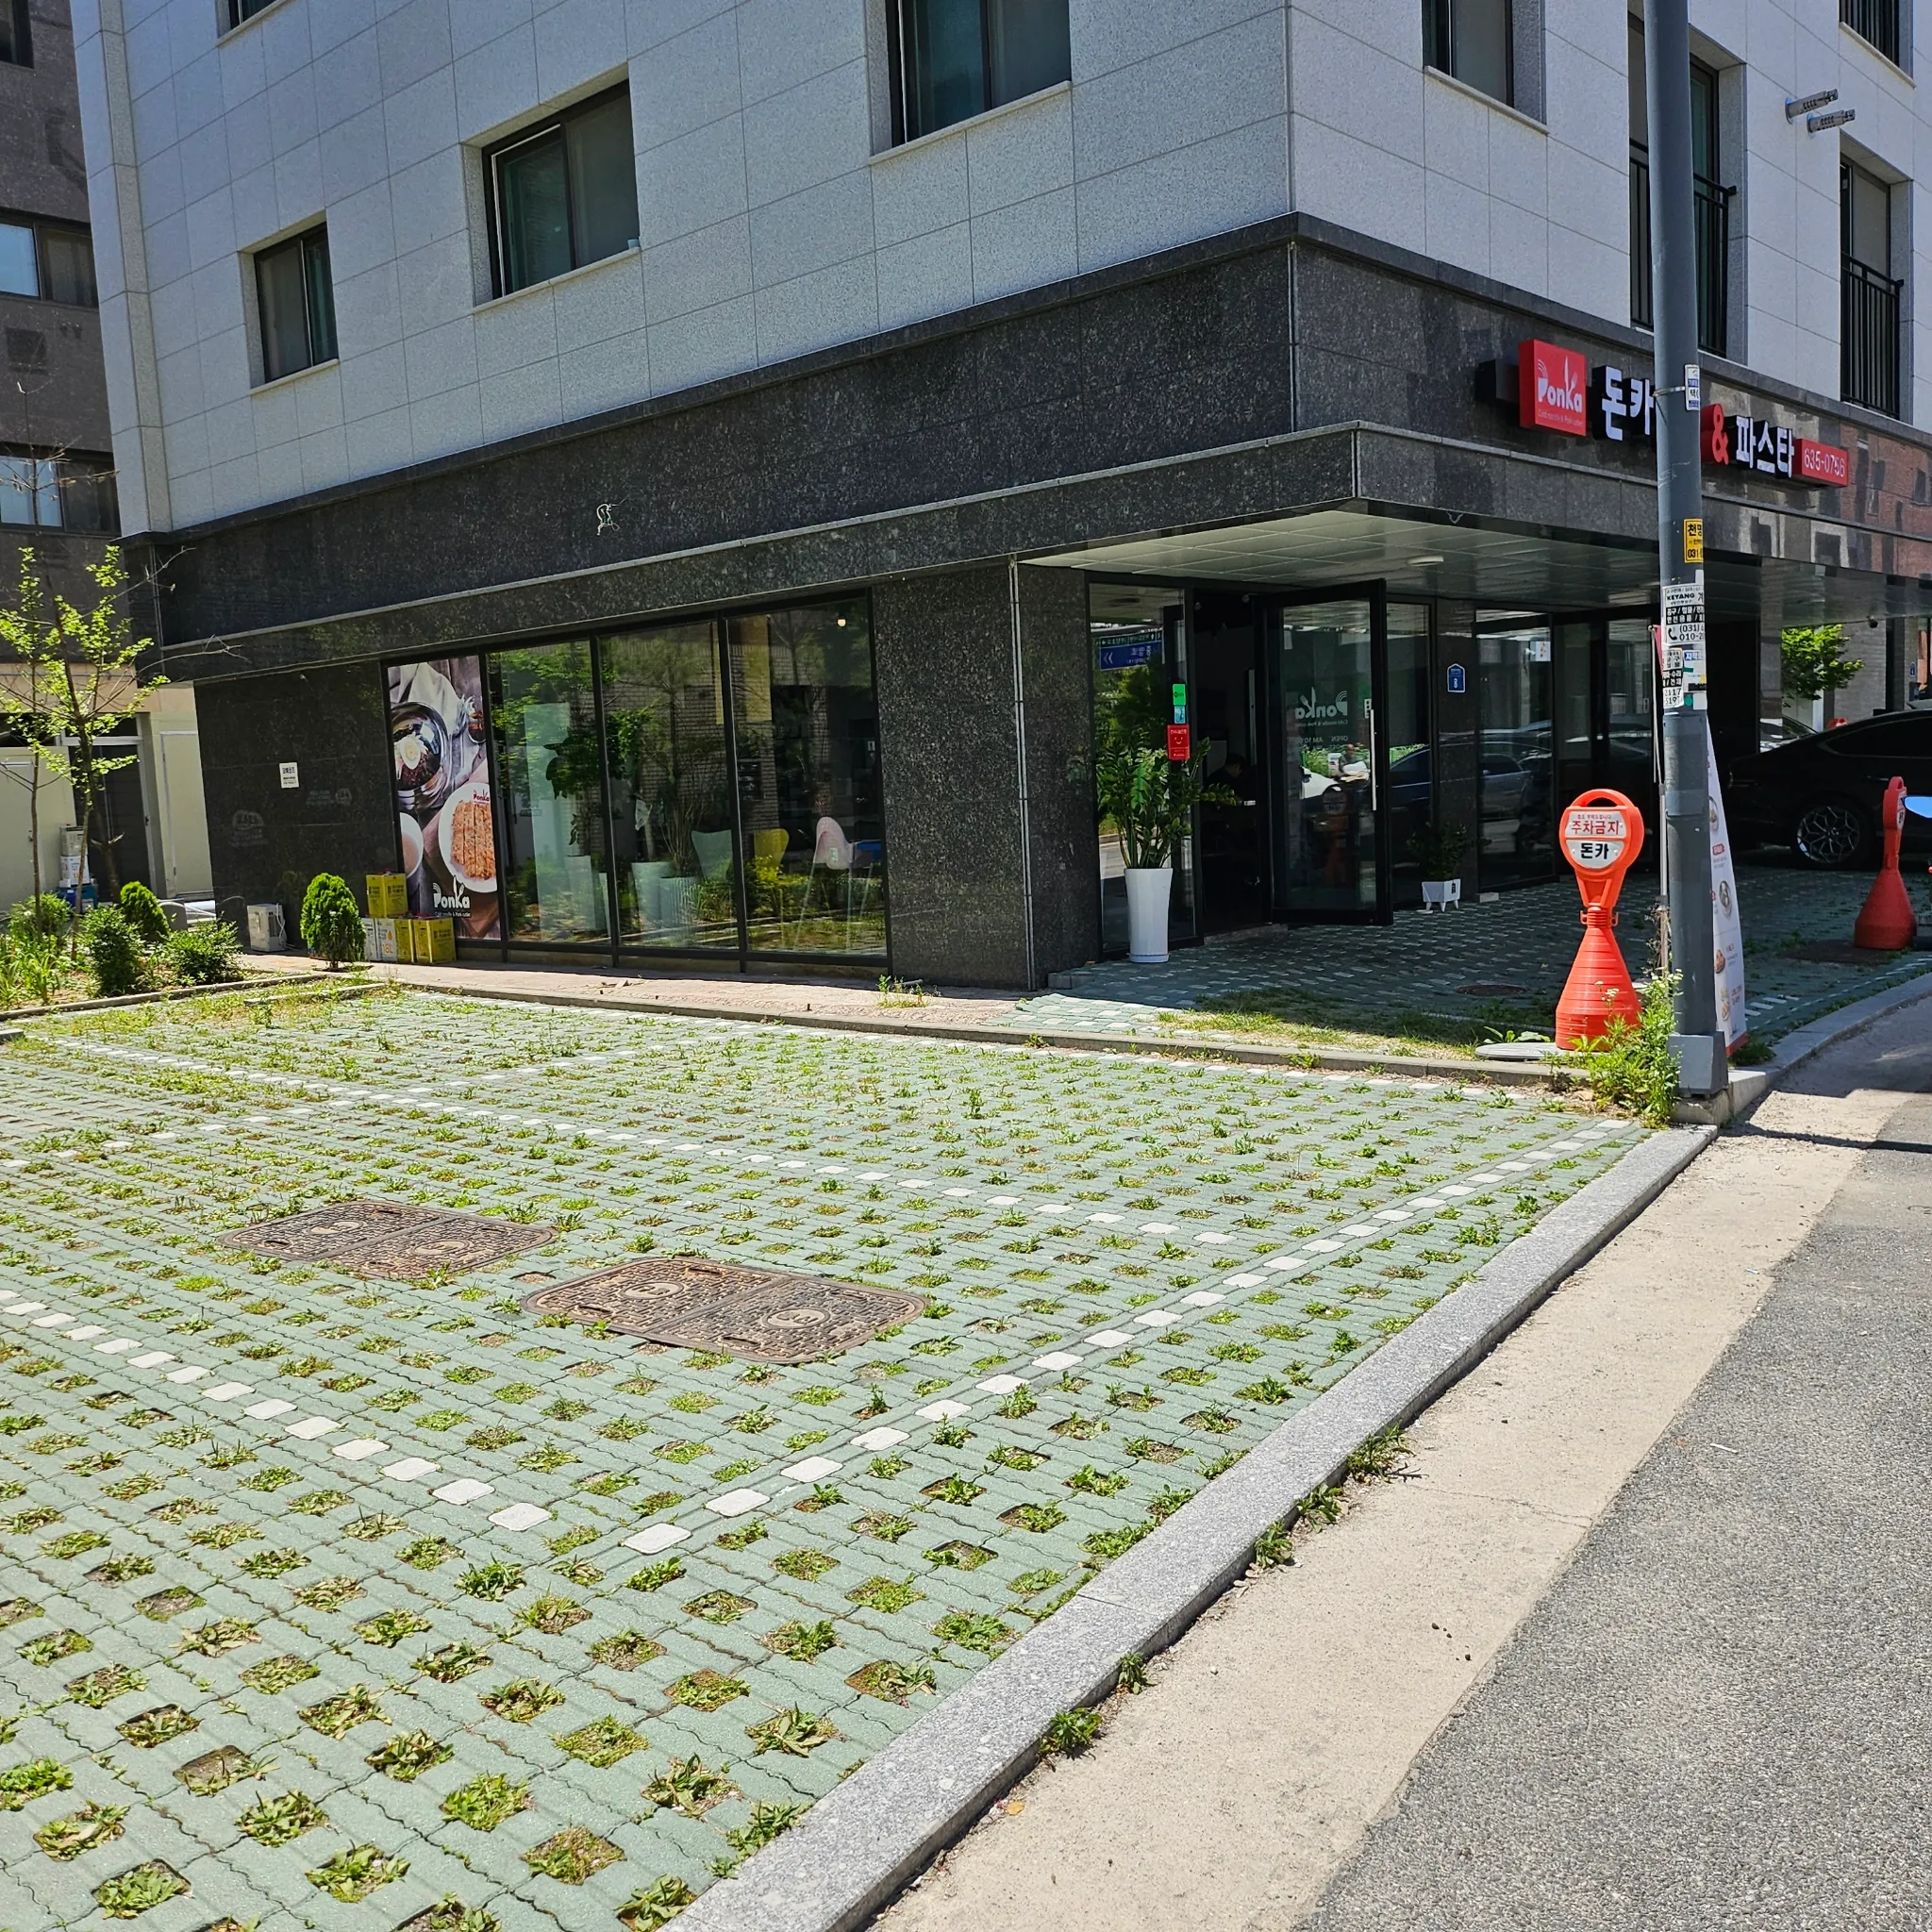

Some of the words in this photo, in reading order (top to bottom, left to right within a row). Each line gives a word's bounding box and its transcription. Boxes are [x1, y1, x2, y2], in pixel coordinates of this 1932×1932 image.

[1602, 365, 1655, 441] 돈카
[1712, 404, 1729, 465] &
[1736, 415, 1794, 478] 파스타
[1571, 820, 1619, 835] 주차금지
[1580, 842, 1609, 859] 돈카
